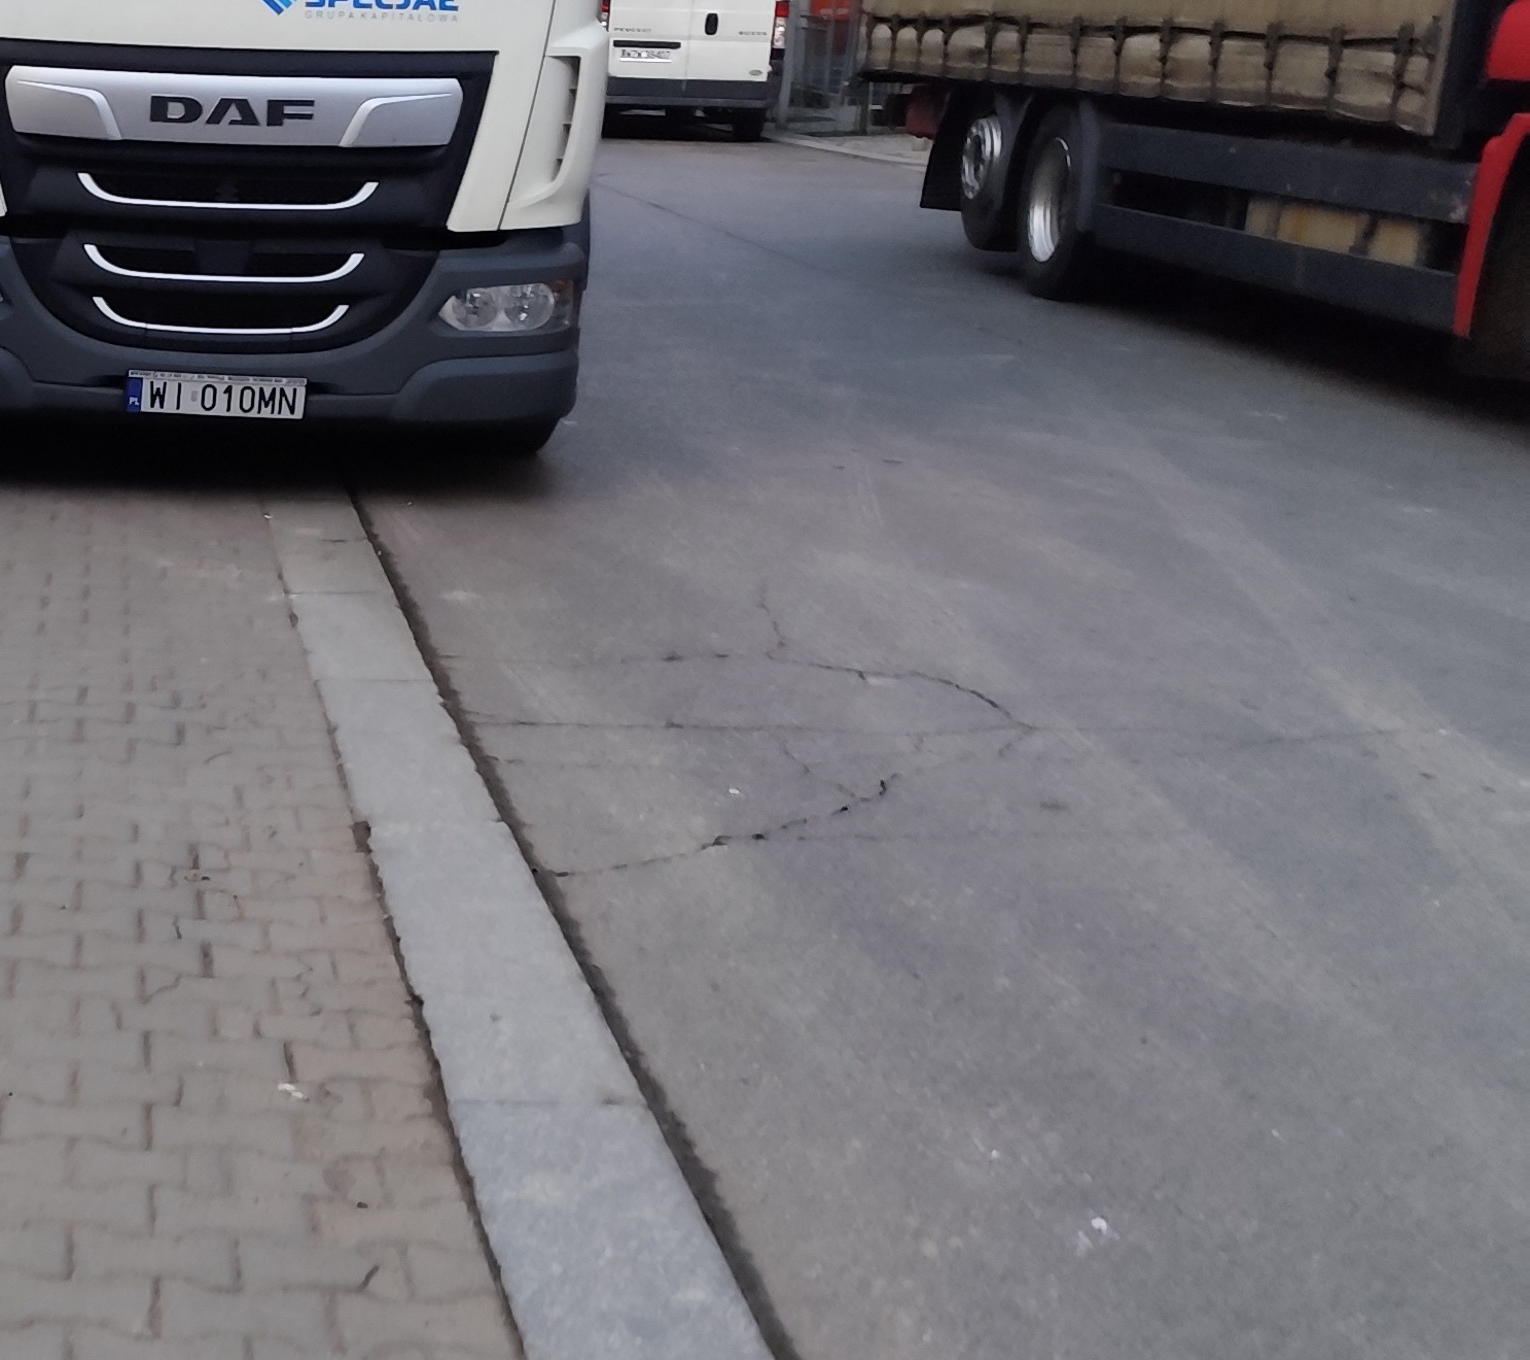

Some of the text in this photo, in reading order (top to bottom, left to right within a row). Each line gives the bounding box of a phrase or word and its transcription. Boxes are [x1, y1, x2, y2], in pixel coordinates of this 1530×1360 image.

[304, 10, 354, 20] GRUPA
[150, 95, 316, 127] DAF
[149, 380, 182, 411] WI
[200, 383, 298, 416] 010MN
